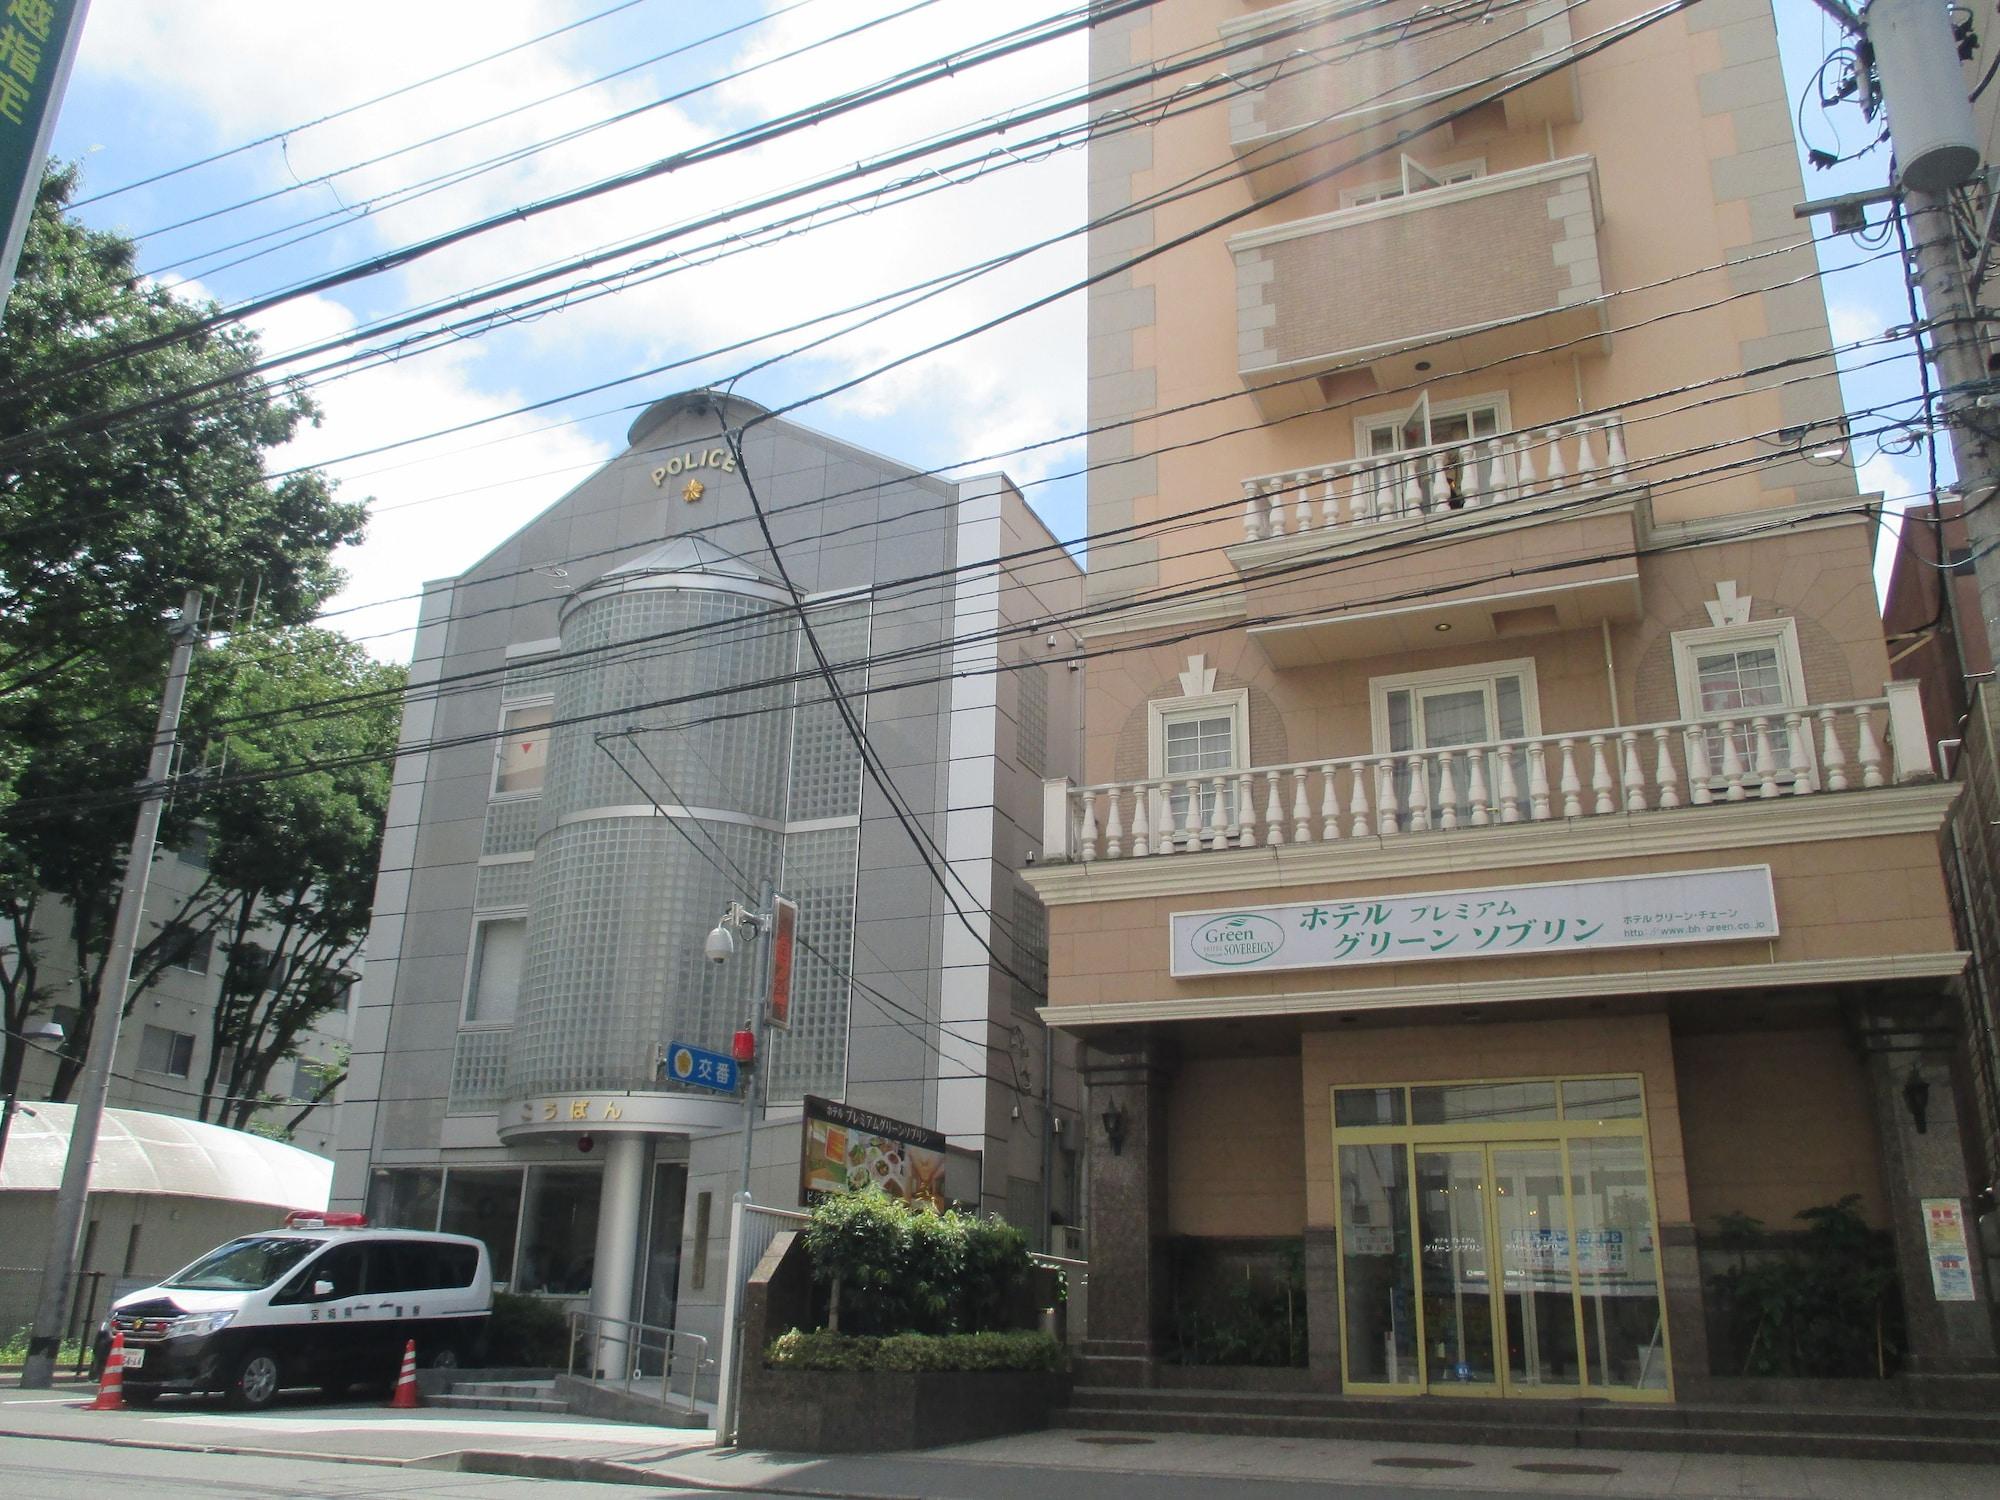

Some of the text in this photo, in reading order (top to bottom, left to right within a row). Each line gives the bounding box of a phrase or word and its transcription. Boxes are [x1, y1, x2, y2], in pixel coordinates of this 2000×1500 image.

[652, 448, 738, 487] POLICE
[1300, 904, 1393, 930] ホテル
[1623, 913, 1651, 925] ホテル
[1205, 928, 1254, 943] Green
[1334, 918, 1604, 959] グリーン ソブリン
[1224, 941, 1273, 956] SOVEREIGN
[698, 1059, 730, 1085] 交番
[521, 1100, 623, 1120] こうばん
